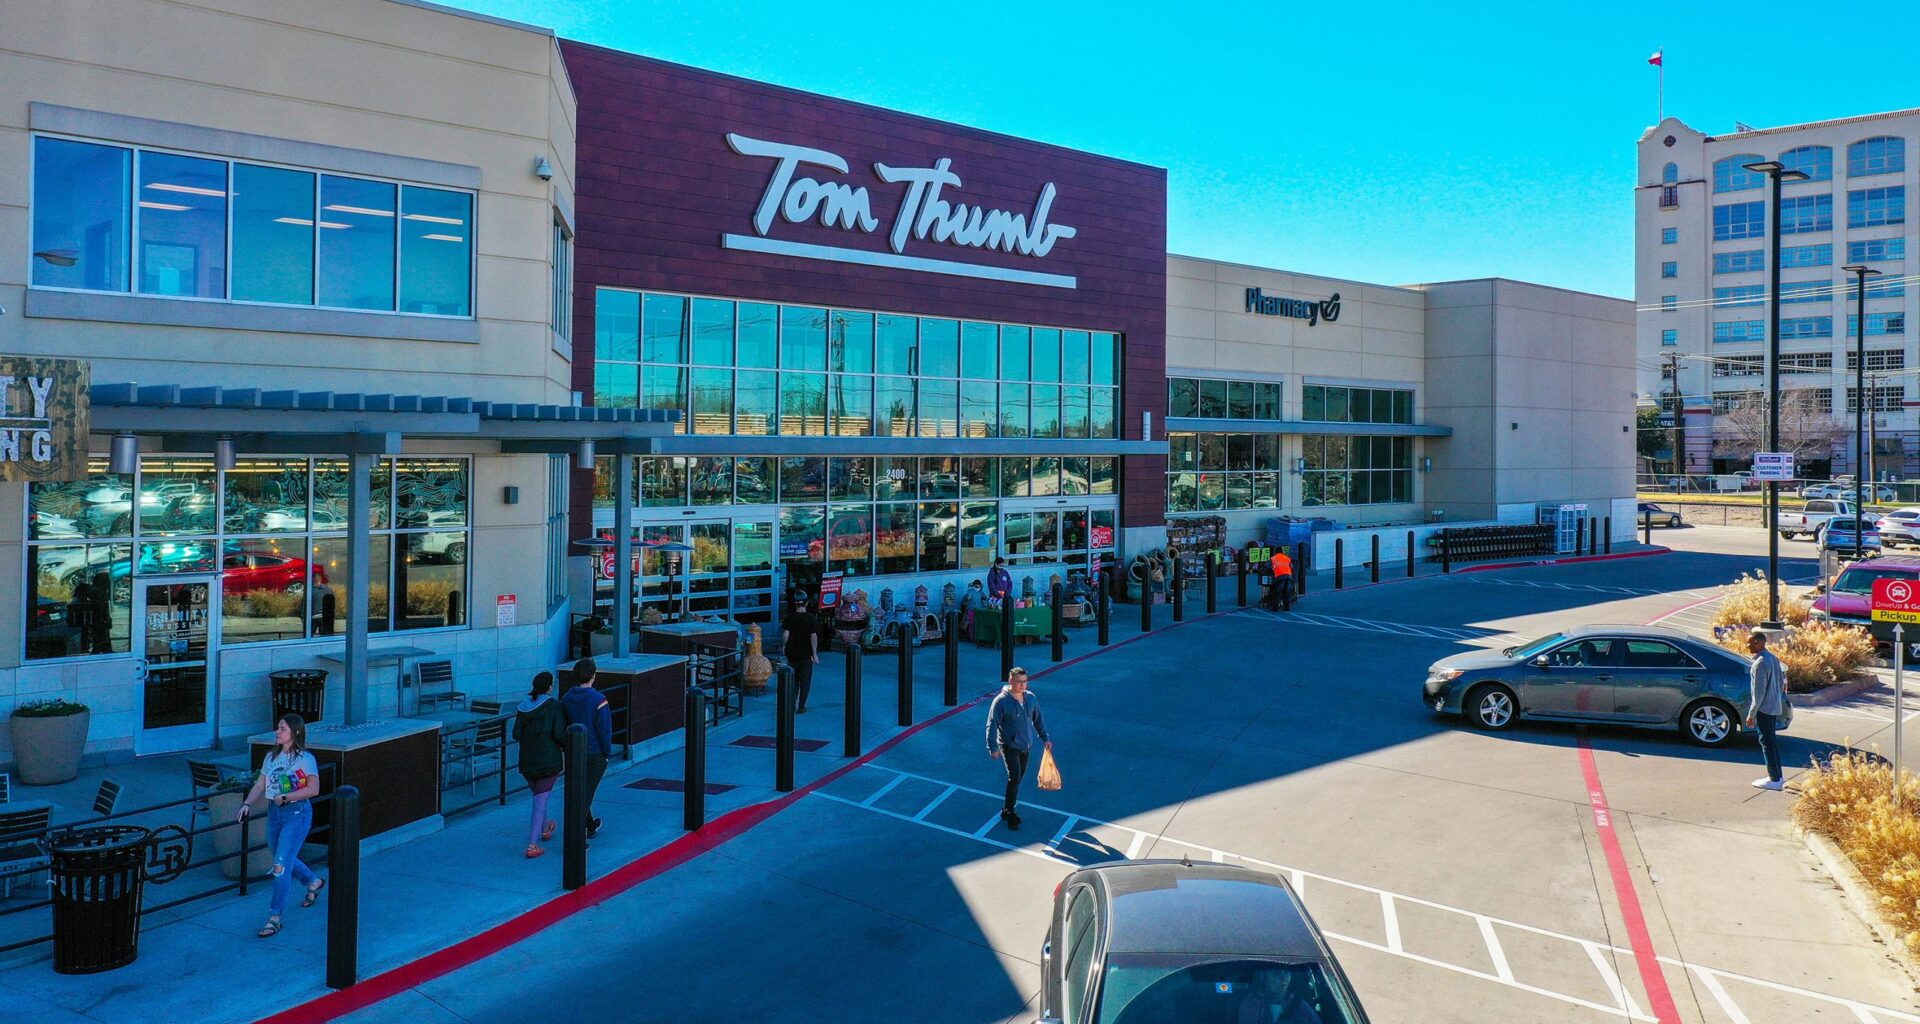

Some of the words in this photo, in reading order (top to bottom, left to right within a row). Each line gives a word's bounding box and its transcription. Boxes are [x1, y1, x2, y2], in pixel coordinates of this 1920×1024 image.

[726, 132, 879, 237] Tom
[874, 158, 1077, 257] Thumb
[1245, 287, 1320, 327] Pharmacy
[885, 468, 906, 480] 2400
[1875, 601, 1902, 609] DriveUp
[1880, 610, 1917, 622] Pickup
